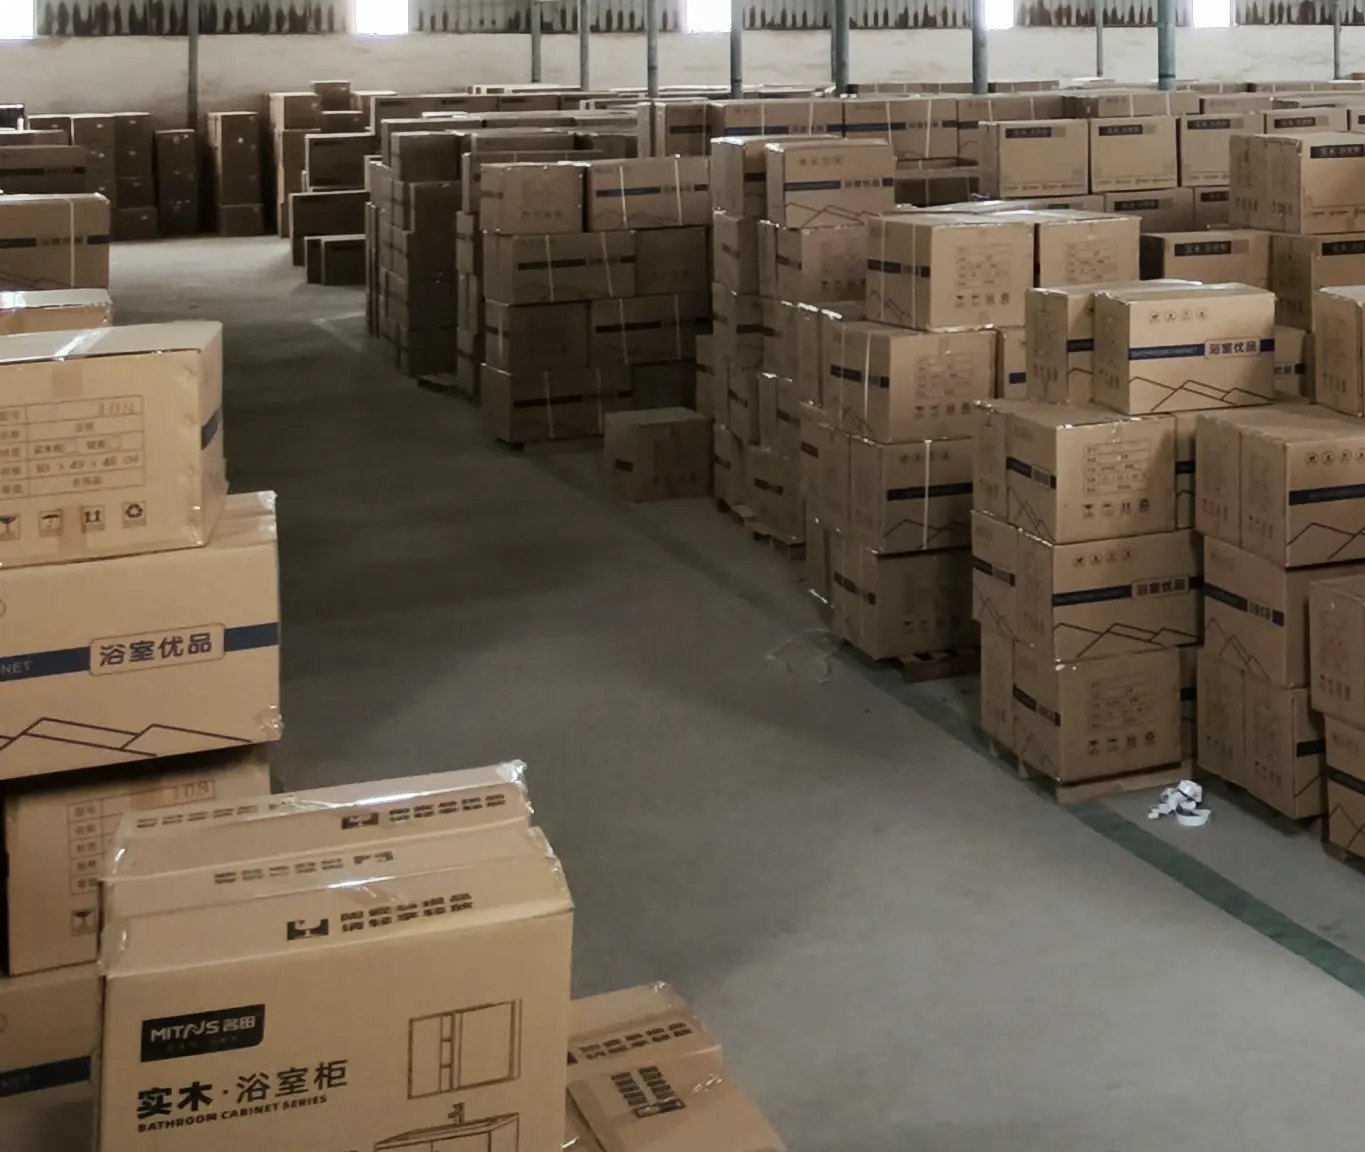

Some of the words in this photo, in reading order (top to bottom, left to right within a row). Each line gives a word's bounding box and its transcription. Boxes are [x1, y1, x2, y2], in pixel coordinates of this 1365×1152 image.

[100, 632, 213, 666] 浴室优品
[137, 1059, 349, 1120] 实木·浴室柜
[138, 1111, 217, 1133] BATHROOM
[221, 1101, 280, 1121] CABINET
[282, 1095, 328, 1110] SERIES
